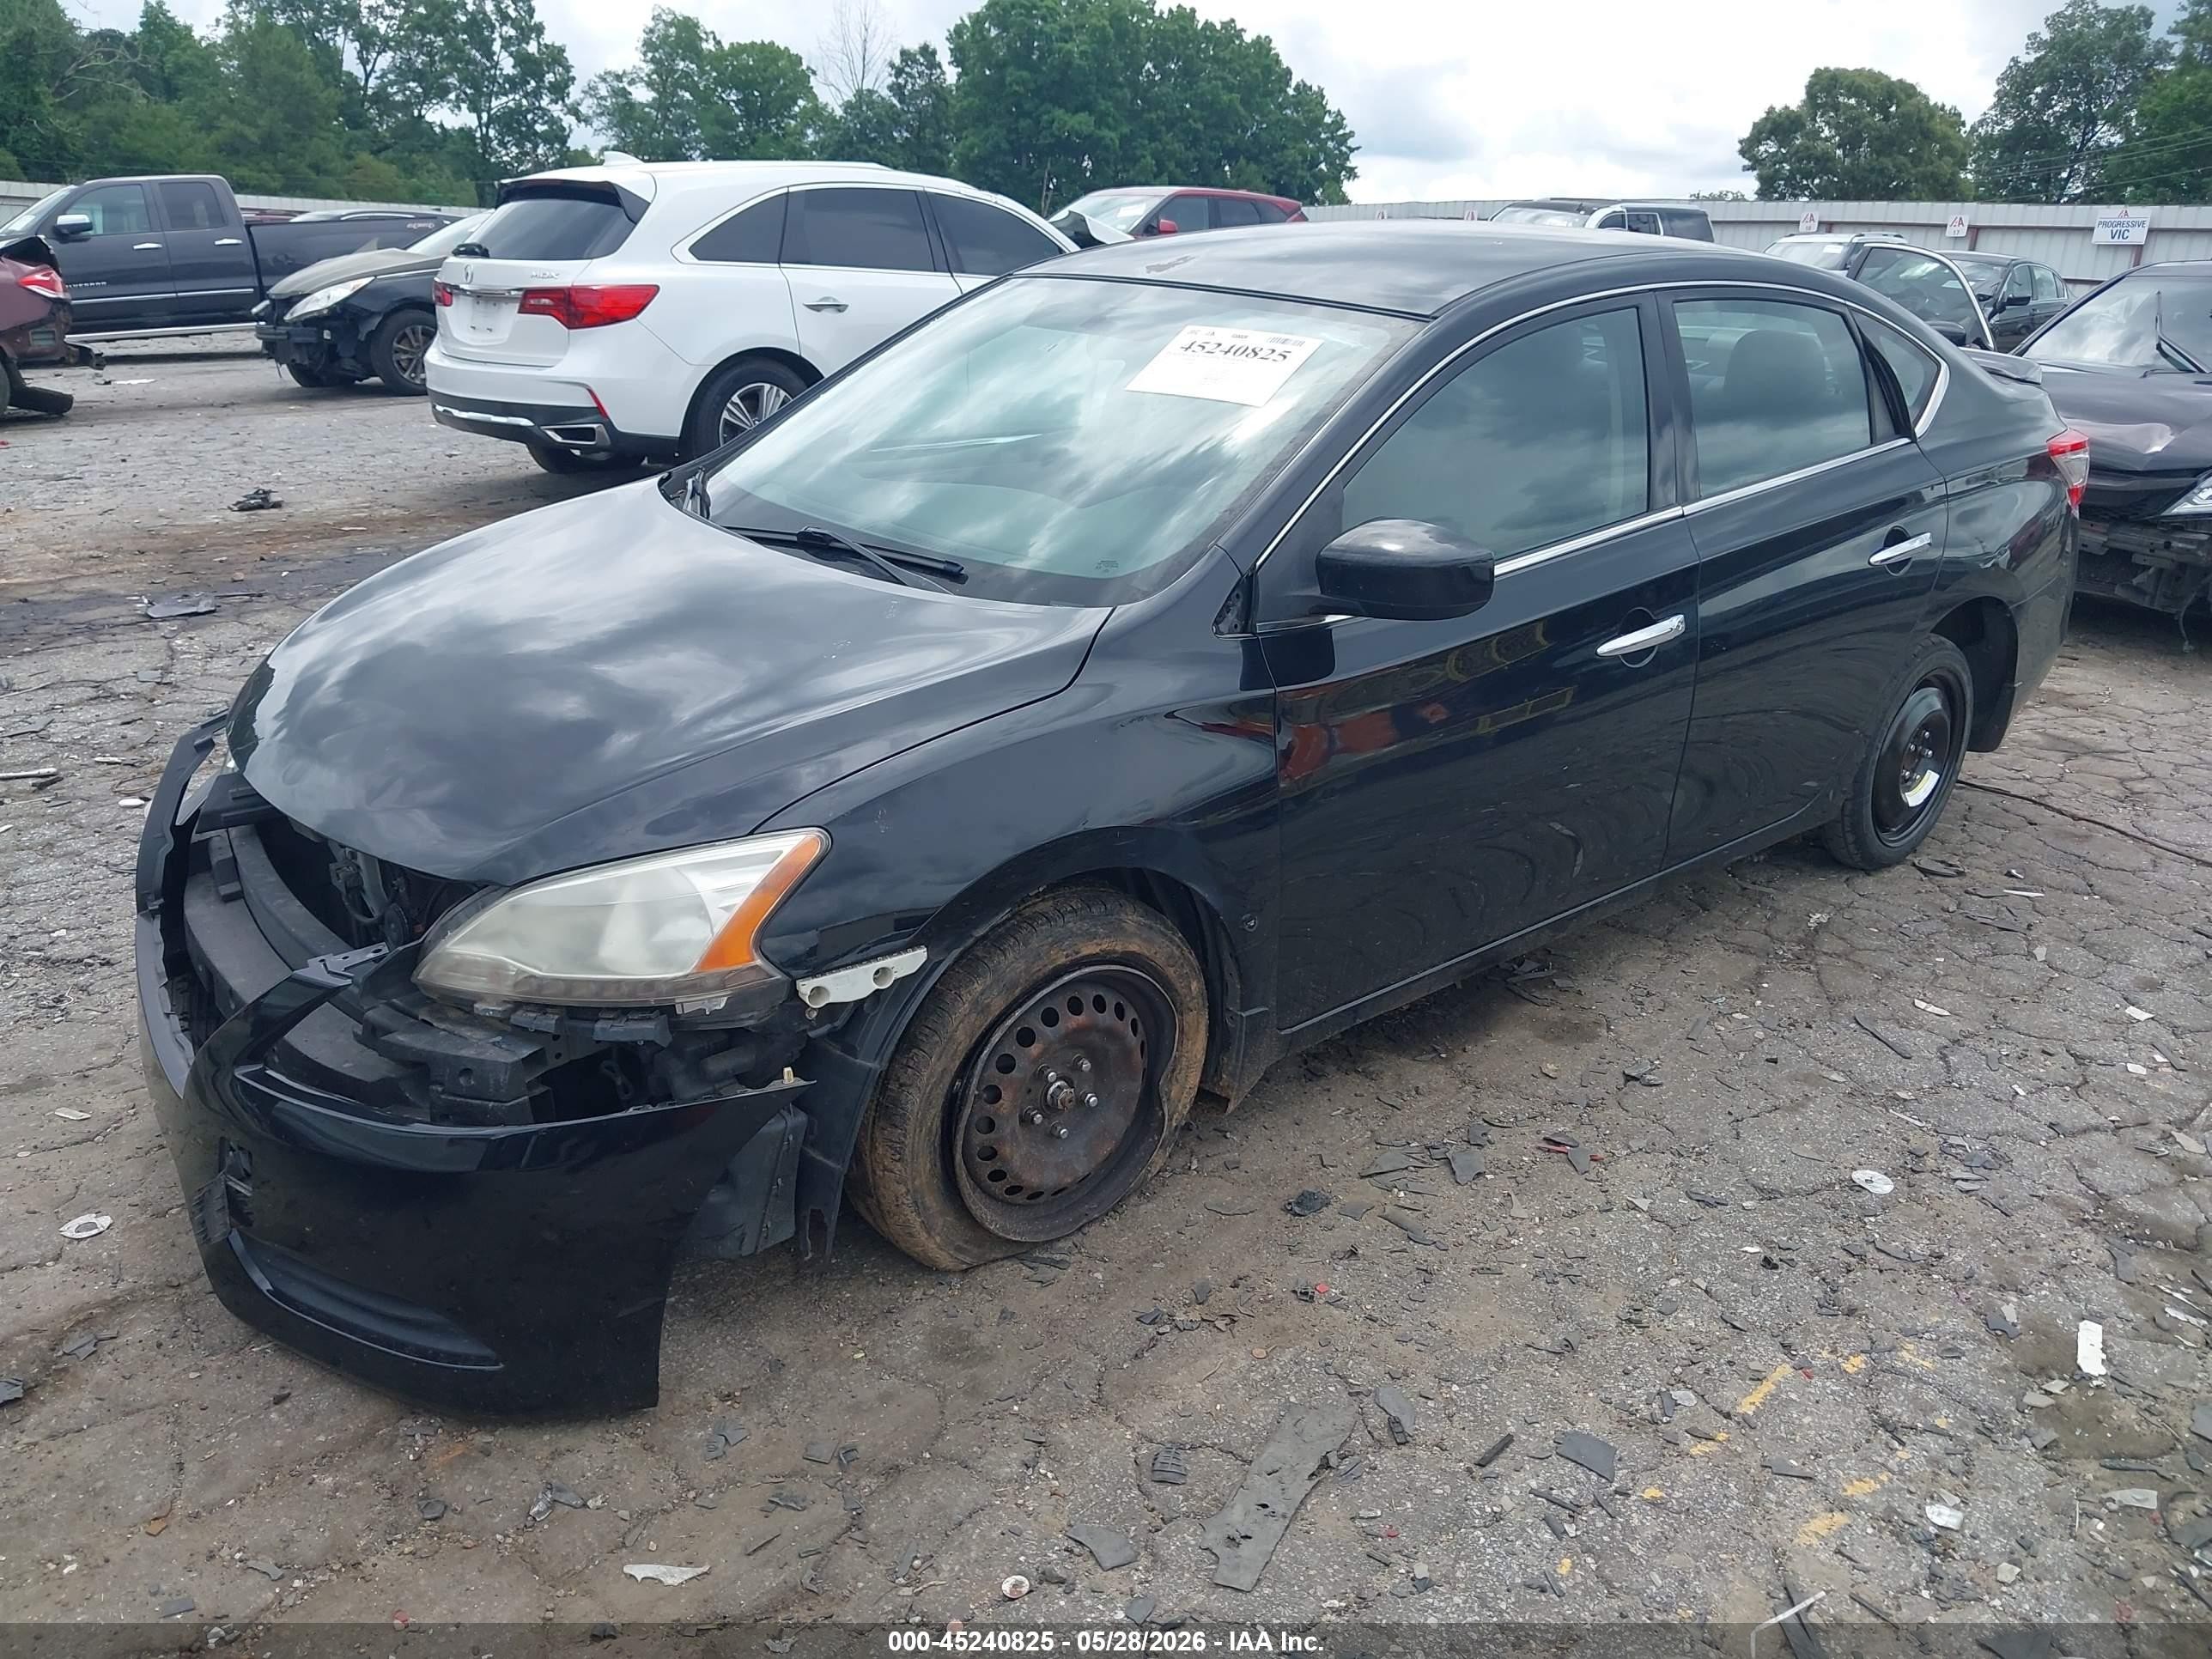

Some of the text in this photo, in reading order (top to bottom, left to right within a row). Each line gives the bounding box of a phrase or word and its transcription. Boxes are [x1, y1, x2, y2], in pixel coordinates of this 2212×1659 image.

[2097, 220, 2148, 228] PROGRESSIVE
[2110, 228, 2130, 240] VIC
[1180, 340, 1291, 362] 45240825
